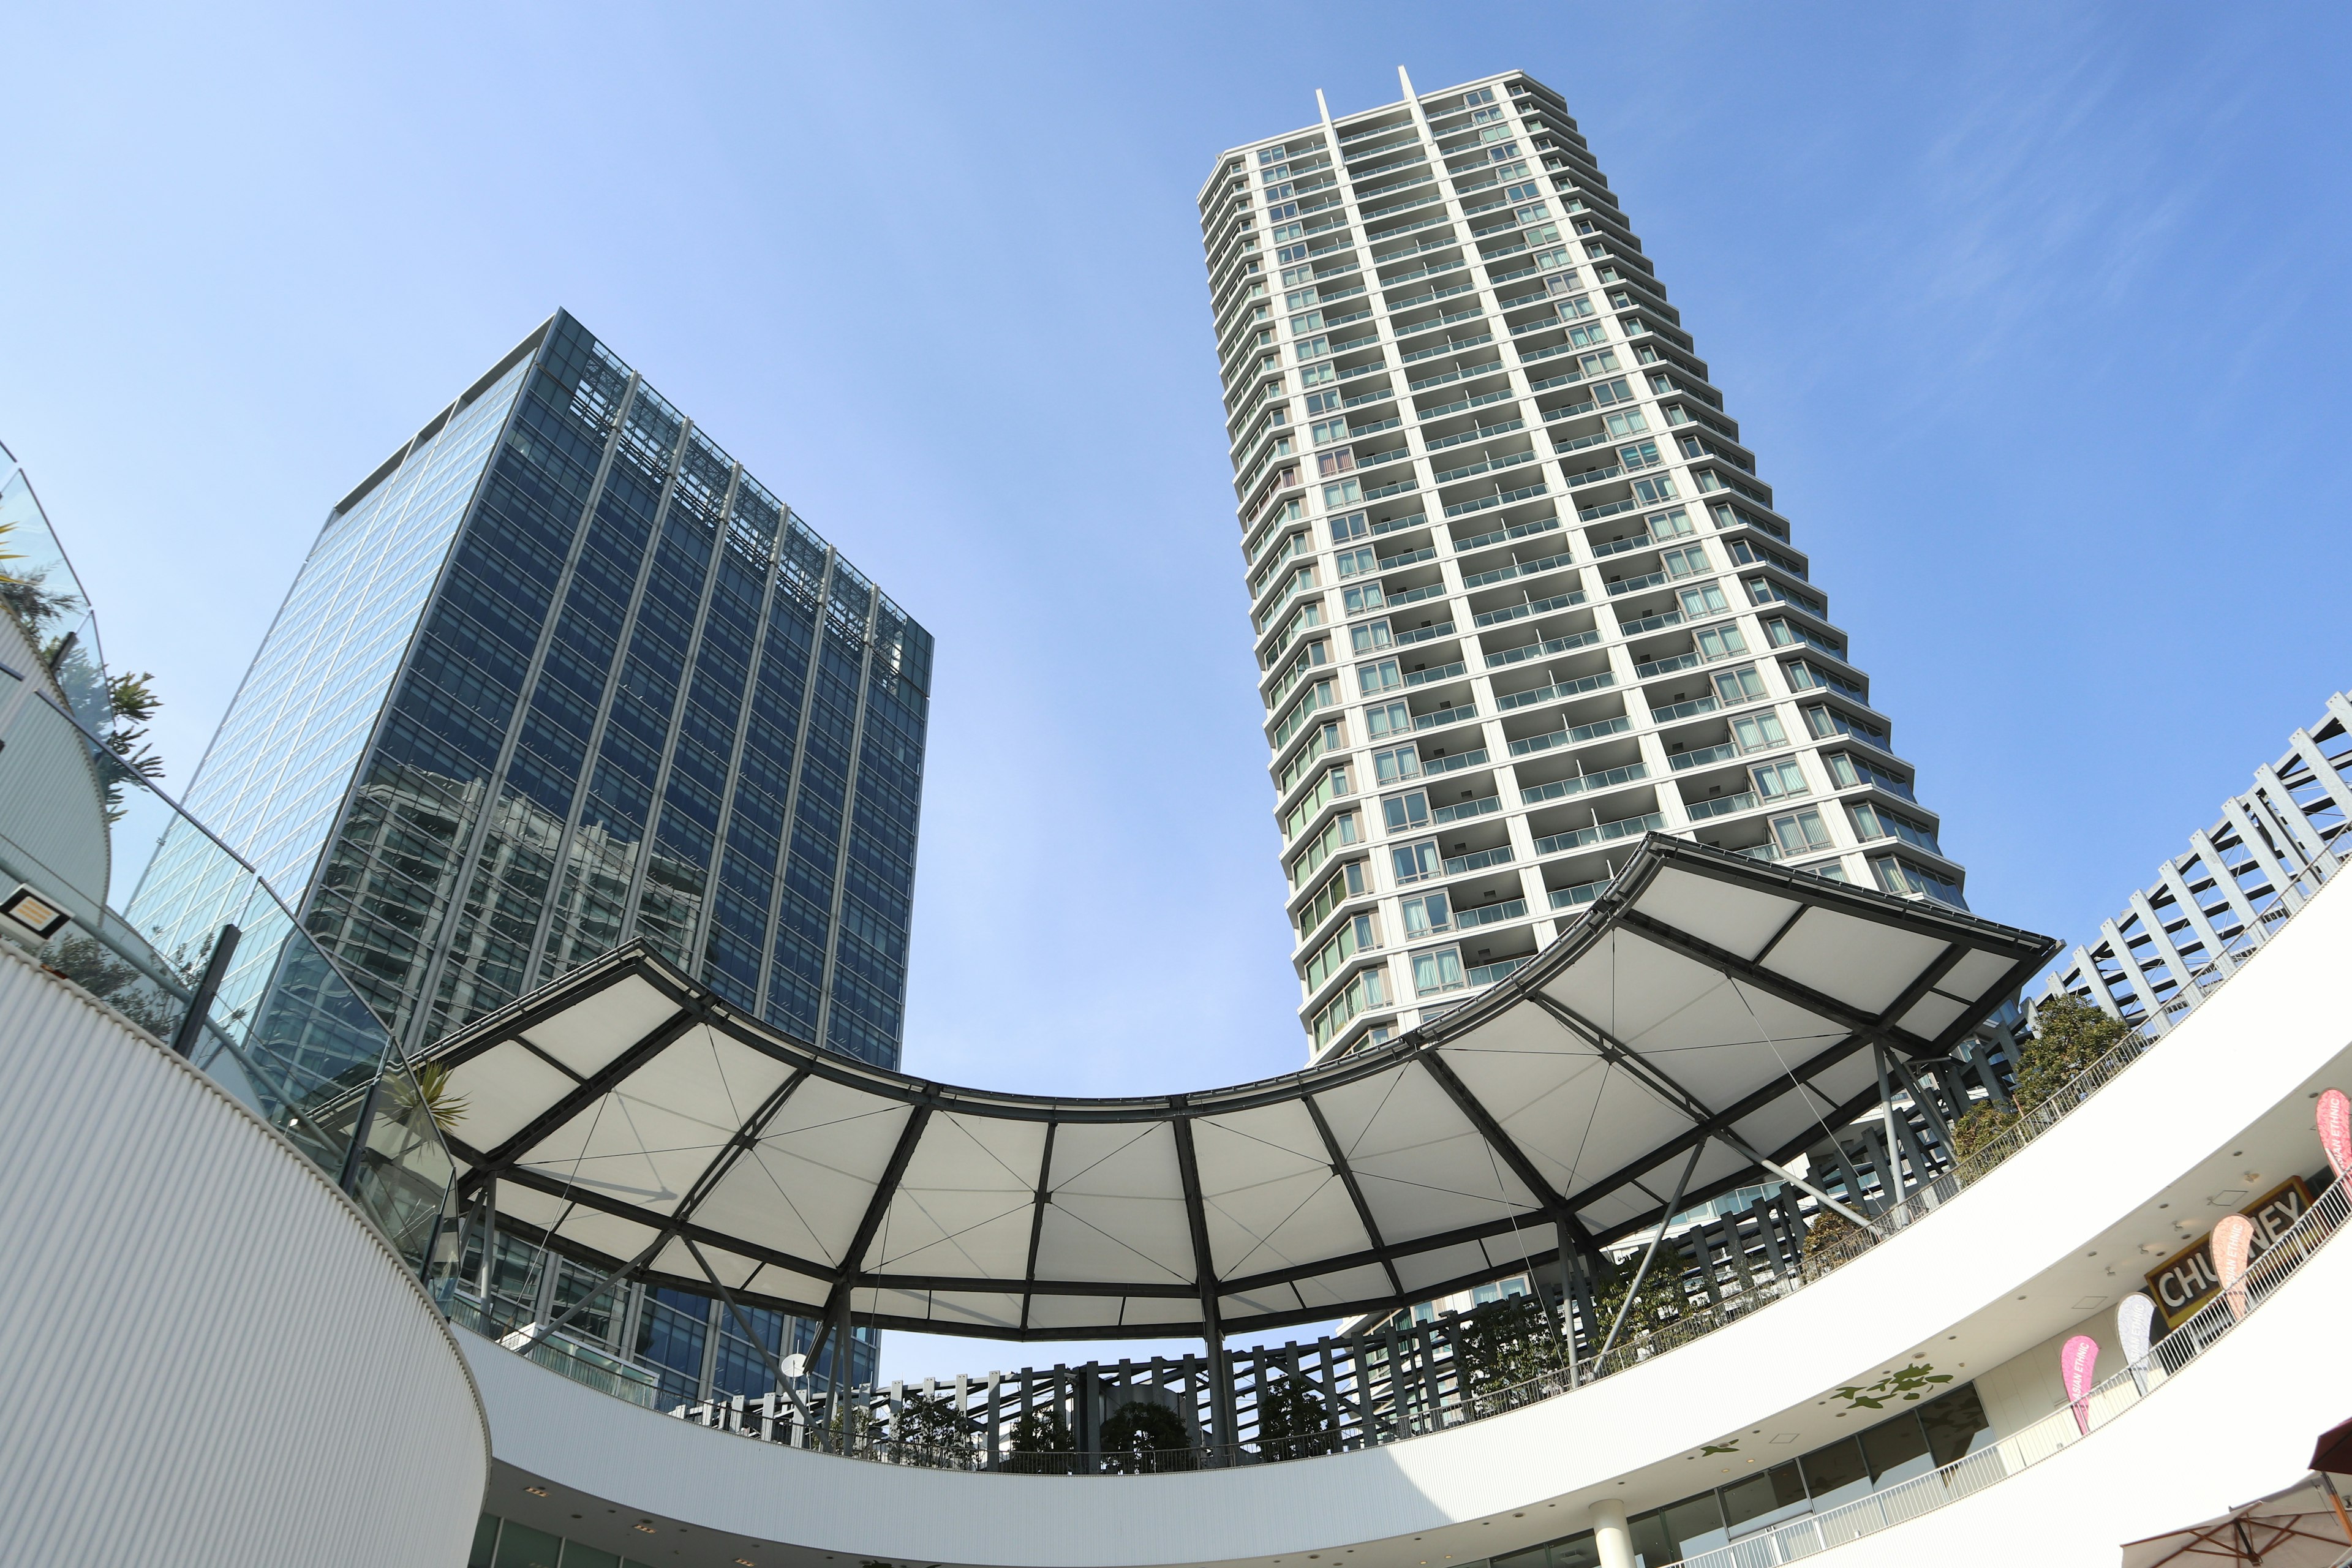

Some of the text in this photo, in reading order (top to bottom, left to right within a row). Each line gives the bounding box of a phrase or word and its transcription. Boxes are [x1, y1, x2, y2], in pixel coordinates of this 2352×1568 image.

[2330, 1098, 2340, 1137] ETHNIC
[2158, 1191, 2299, 1307] CHUNEY
[2226, 1224, 2242, 1257] ETHNIC
[2132, 1304, 2144, 1335] ETHNIC
[2071, 1343, 2089, 1400] ASIAN ETHNIC
